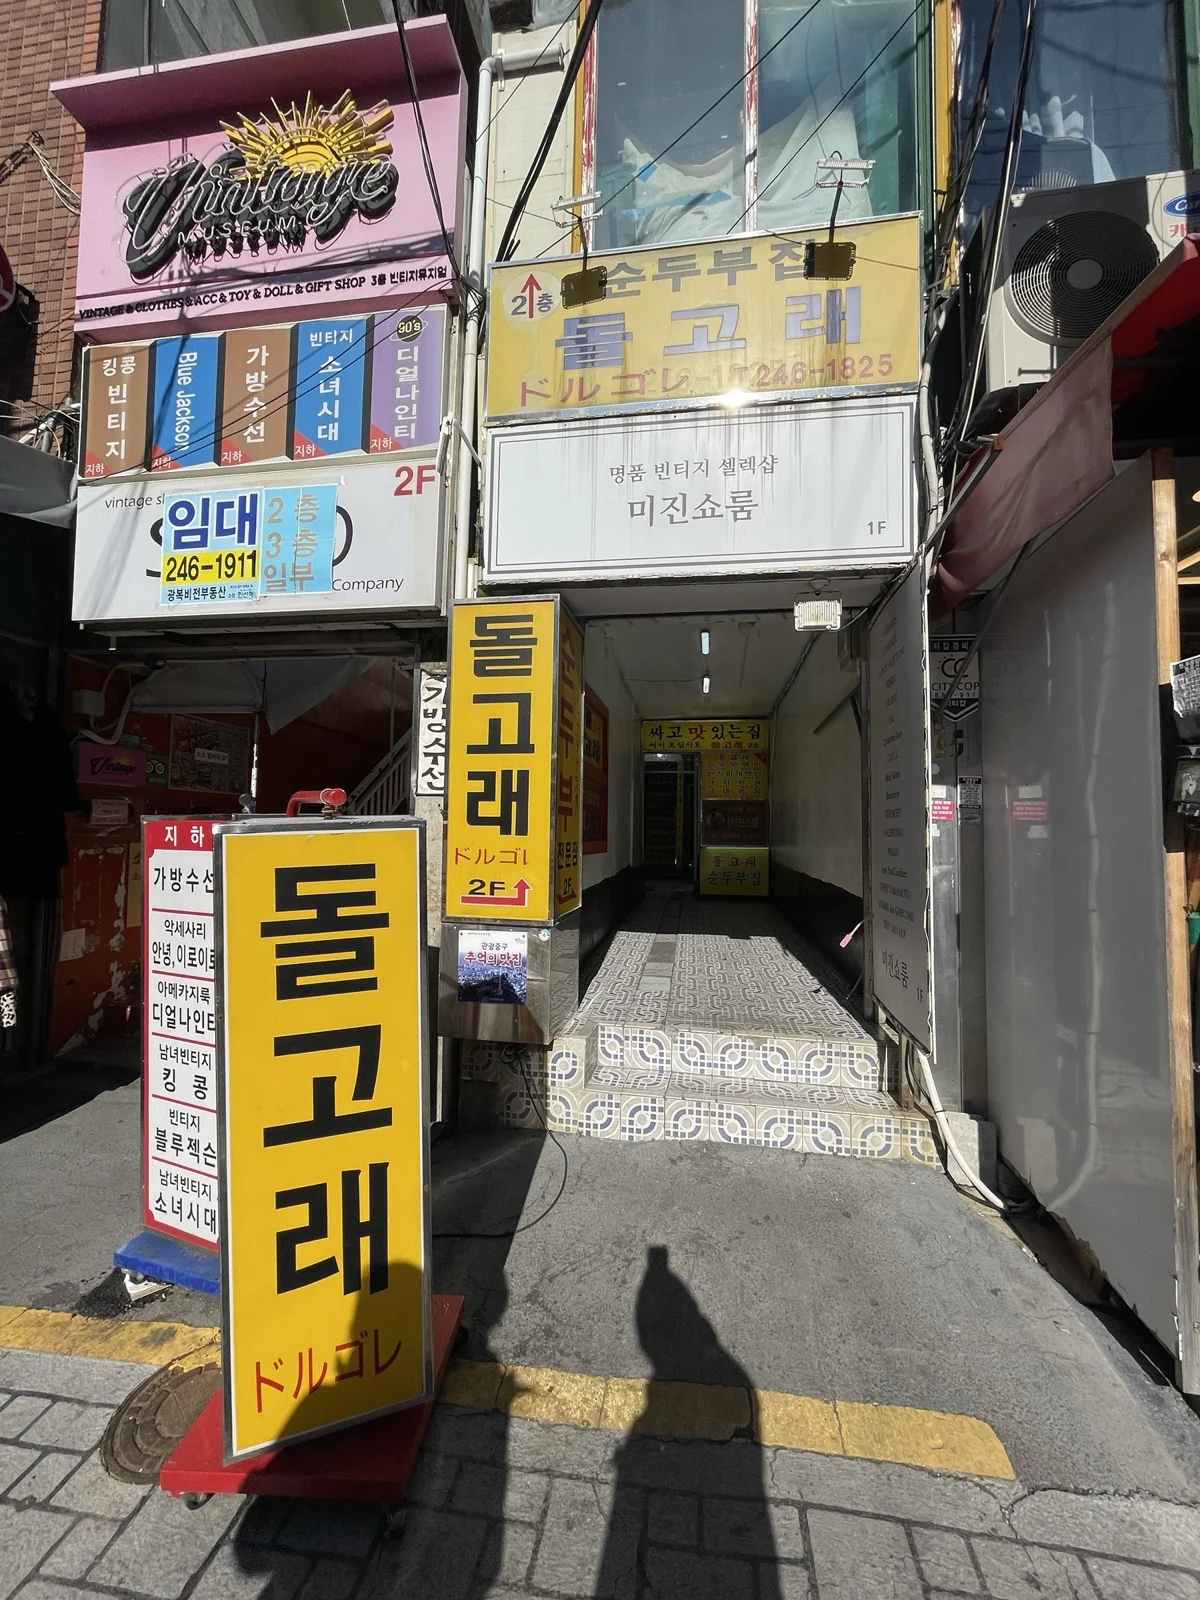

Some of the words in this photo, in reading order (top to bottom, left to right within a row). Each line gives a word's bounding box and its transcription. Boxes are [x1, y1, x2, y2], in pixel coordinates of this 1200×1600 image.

[115, 142, 399, 277] Vintage
[177, 216, 304, 250] MUSEUM
[80, 307, 124, 319] VINTAGE
[135, 300, 184, 313] CLOTHES
[194, 293, 218, 306] ACC
[219, 292, 228, 303] &
[229, 289, 252, 301] TOY
[253, 287, 262, 299] &
[264, 283, 295, 298] DOLL
[295, 283, 304, 294] &
[305, 278, 332, 293] GIFT
[335, 276, 366, 290] SHOP
[390, 266, 447, 284] 빈티지뮤지엄
[511, 293, 553, 316] 2층
[310, 329, 353, 347] 빈티지
[555, 286, 861, 370] 돌고래
[103, 356, 136, 377] 킹콩
[177, 351, 197, 386] Blue
[243, 345, 269, 443] 가방수선
[317, 355, 343, 441] 소녀시대
[394, 346, 420, 439] 디얼나인티
[521, 368, 690, 407] ドルゴレ
[105, 383, 127, 459] 빈티지
[174, 390, 196, 451] Jackson
[222, 450, 243, 463] 지하
[294, 444, 317, 457] 지하
[370, 437, 394, 450] 지하
[85, 463, 105, 476] 지하
[151, 457, 172, 470] 지하
[609, 464, 646, 485] 명품
[653, 459, 710, 481] 빈티지
[717, 454, 778, 477] 셀렉샵
[394, 464, 436, 496] 2F
[105, 496, 153, 510] vintage
[628, 489, 759, 528] 미진쇼룸
[168, 493, 258, 550] 임대
[867, 521, 887, 536] 1F
[165, 550, 257, 583] 246-1911
[263, 561, 315, 593] 일부
[167, 586, 227, 602] 광복비전부동산
[332, 578, 404, 593] Company
[466, 614, 538, 837] 돌고래
[165, 825, 204, 847] 지하
[154, 866, 214, 894] 가방수선
[468, 878, 506, 896] 2F
[563, 878, 572, 895] 2F
[707, 870, 761, 887] 순두부집
[164, 919, 206, 939] 악세사리
[465, 950, 497, 965] 추억의
[499, 951, 522, 967] 맛집
[882, 948, 908, 989] 미진쇼룸
[157, 981, 210, 1005] 아메카지룩
[159, 1043, 212, 1071] 남녀빈티지
[162, 1067, 208, 1101] 킹콩
[260, 863, 392, 1296] 돌고래
[169, 1108, 200, 1133] 빈티지
[154, 1126, 217, 1168] 블루젝슨
[159, 1168, 212, 1202] 남녀빈티지
[154, 1191, 217, 1235] 소녀시대
[255, 1329, 403, 1414] ドルゴレ
